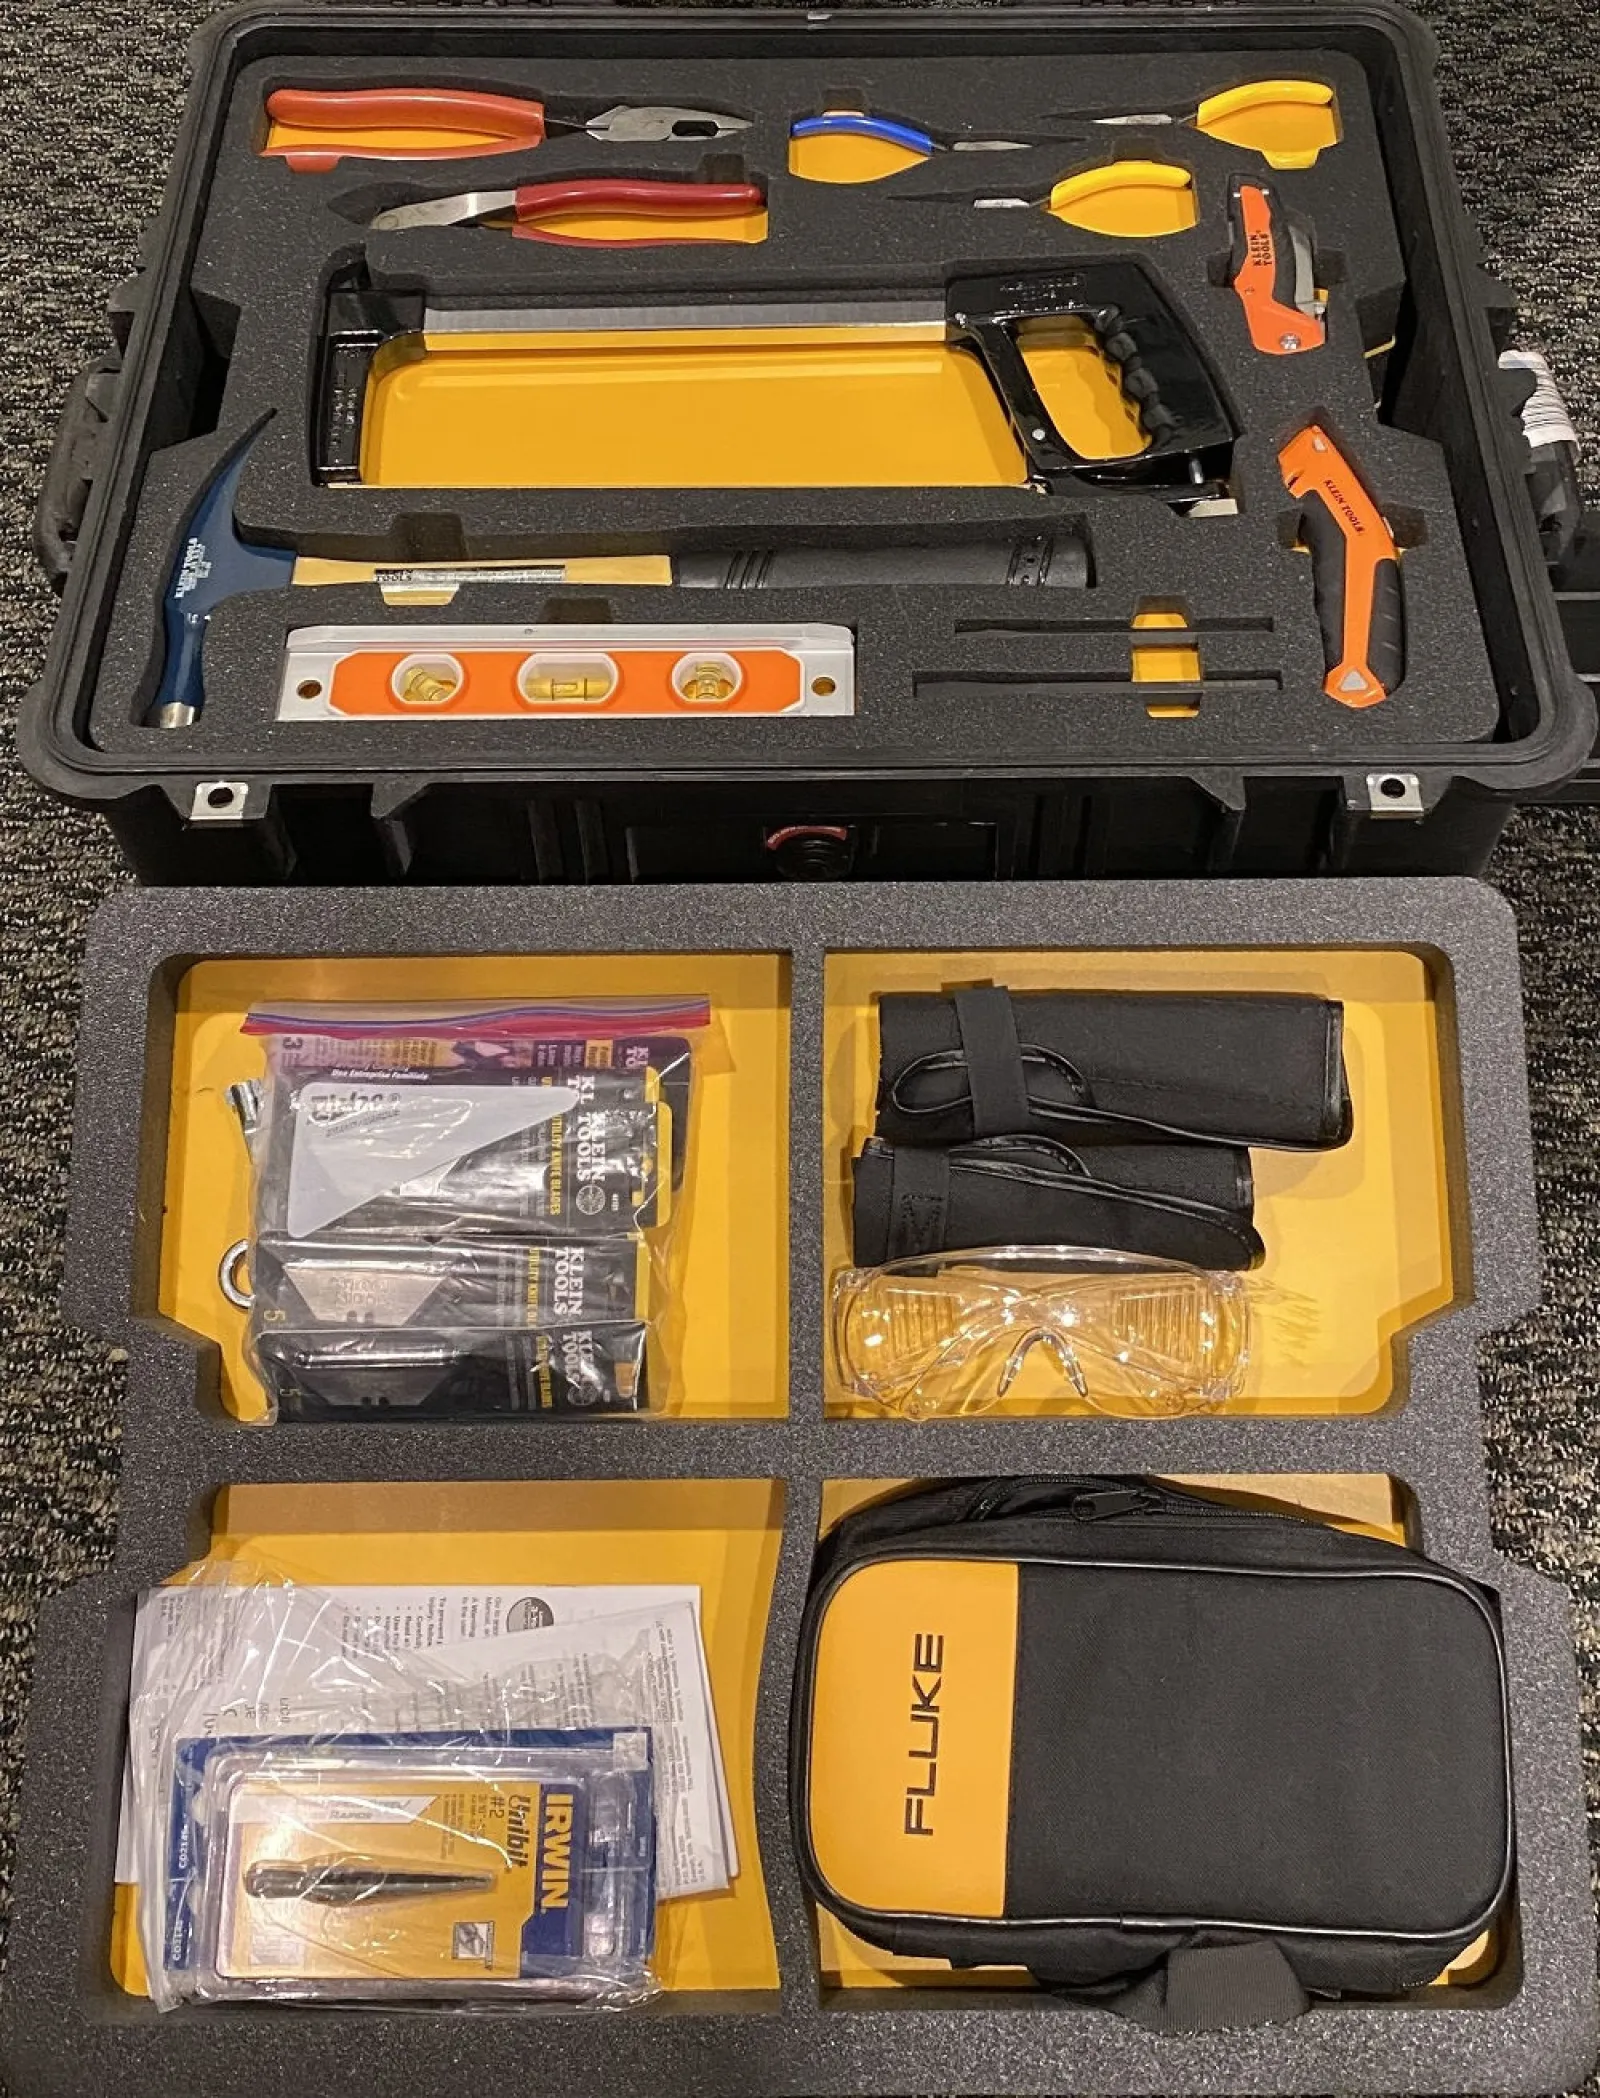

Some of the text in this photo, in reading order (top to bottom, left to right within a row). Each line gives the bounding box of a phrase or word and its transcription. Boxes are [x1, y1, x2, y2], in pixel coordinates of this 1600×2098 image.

[1248, 234, 1261, 266] KLEIN
[1260, 233, 1272, 266] TOOLS
[1324, 480, 1364, 532] KLEIN TOOLS
[576, 1114, 591, 1182] TOOLS
[591, 1112, 606, 1182] KLEIN
[550, 1179, 562, 1216] BLADES
[263, 1309, 286, 1321] 5
[554, 1248, 569, 1316] TOOLS
[568, 1247, 584, 1316] KLEIN
[904, 1633, 945, 1836] FLUKE
[489, 1796, 505, 1819] #2
[506, 1794, 531, 1868] Unibit
[541, 1793, 574, 1909] IRWIN
